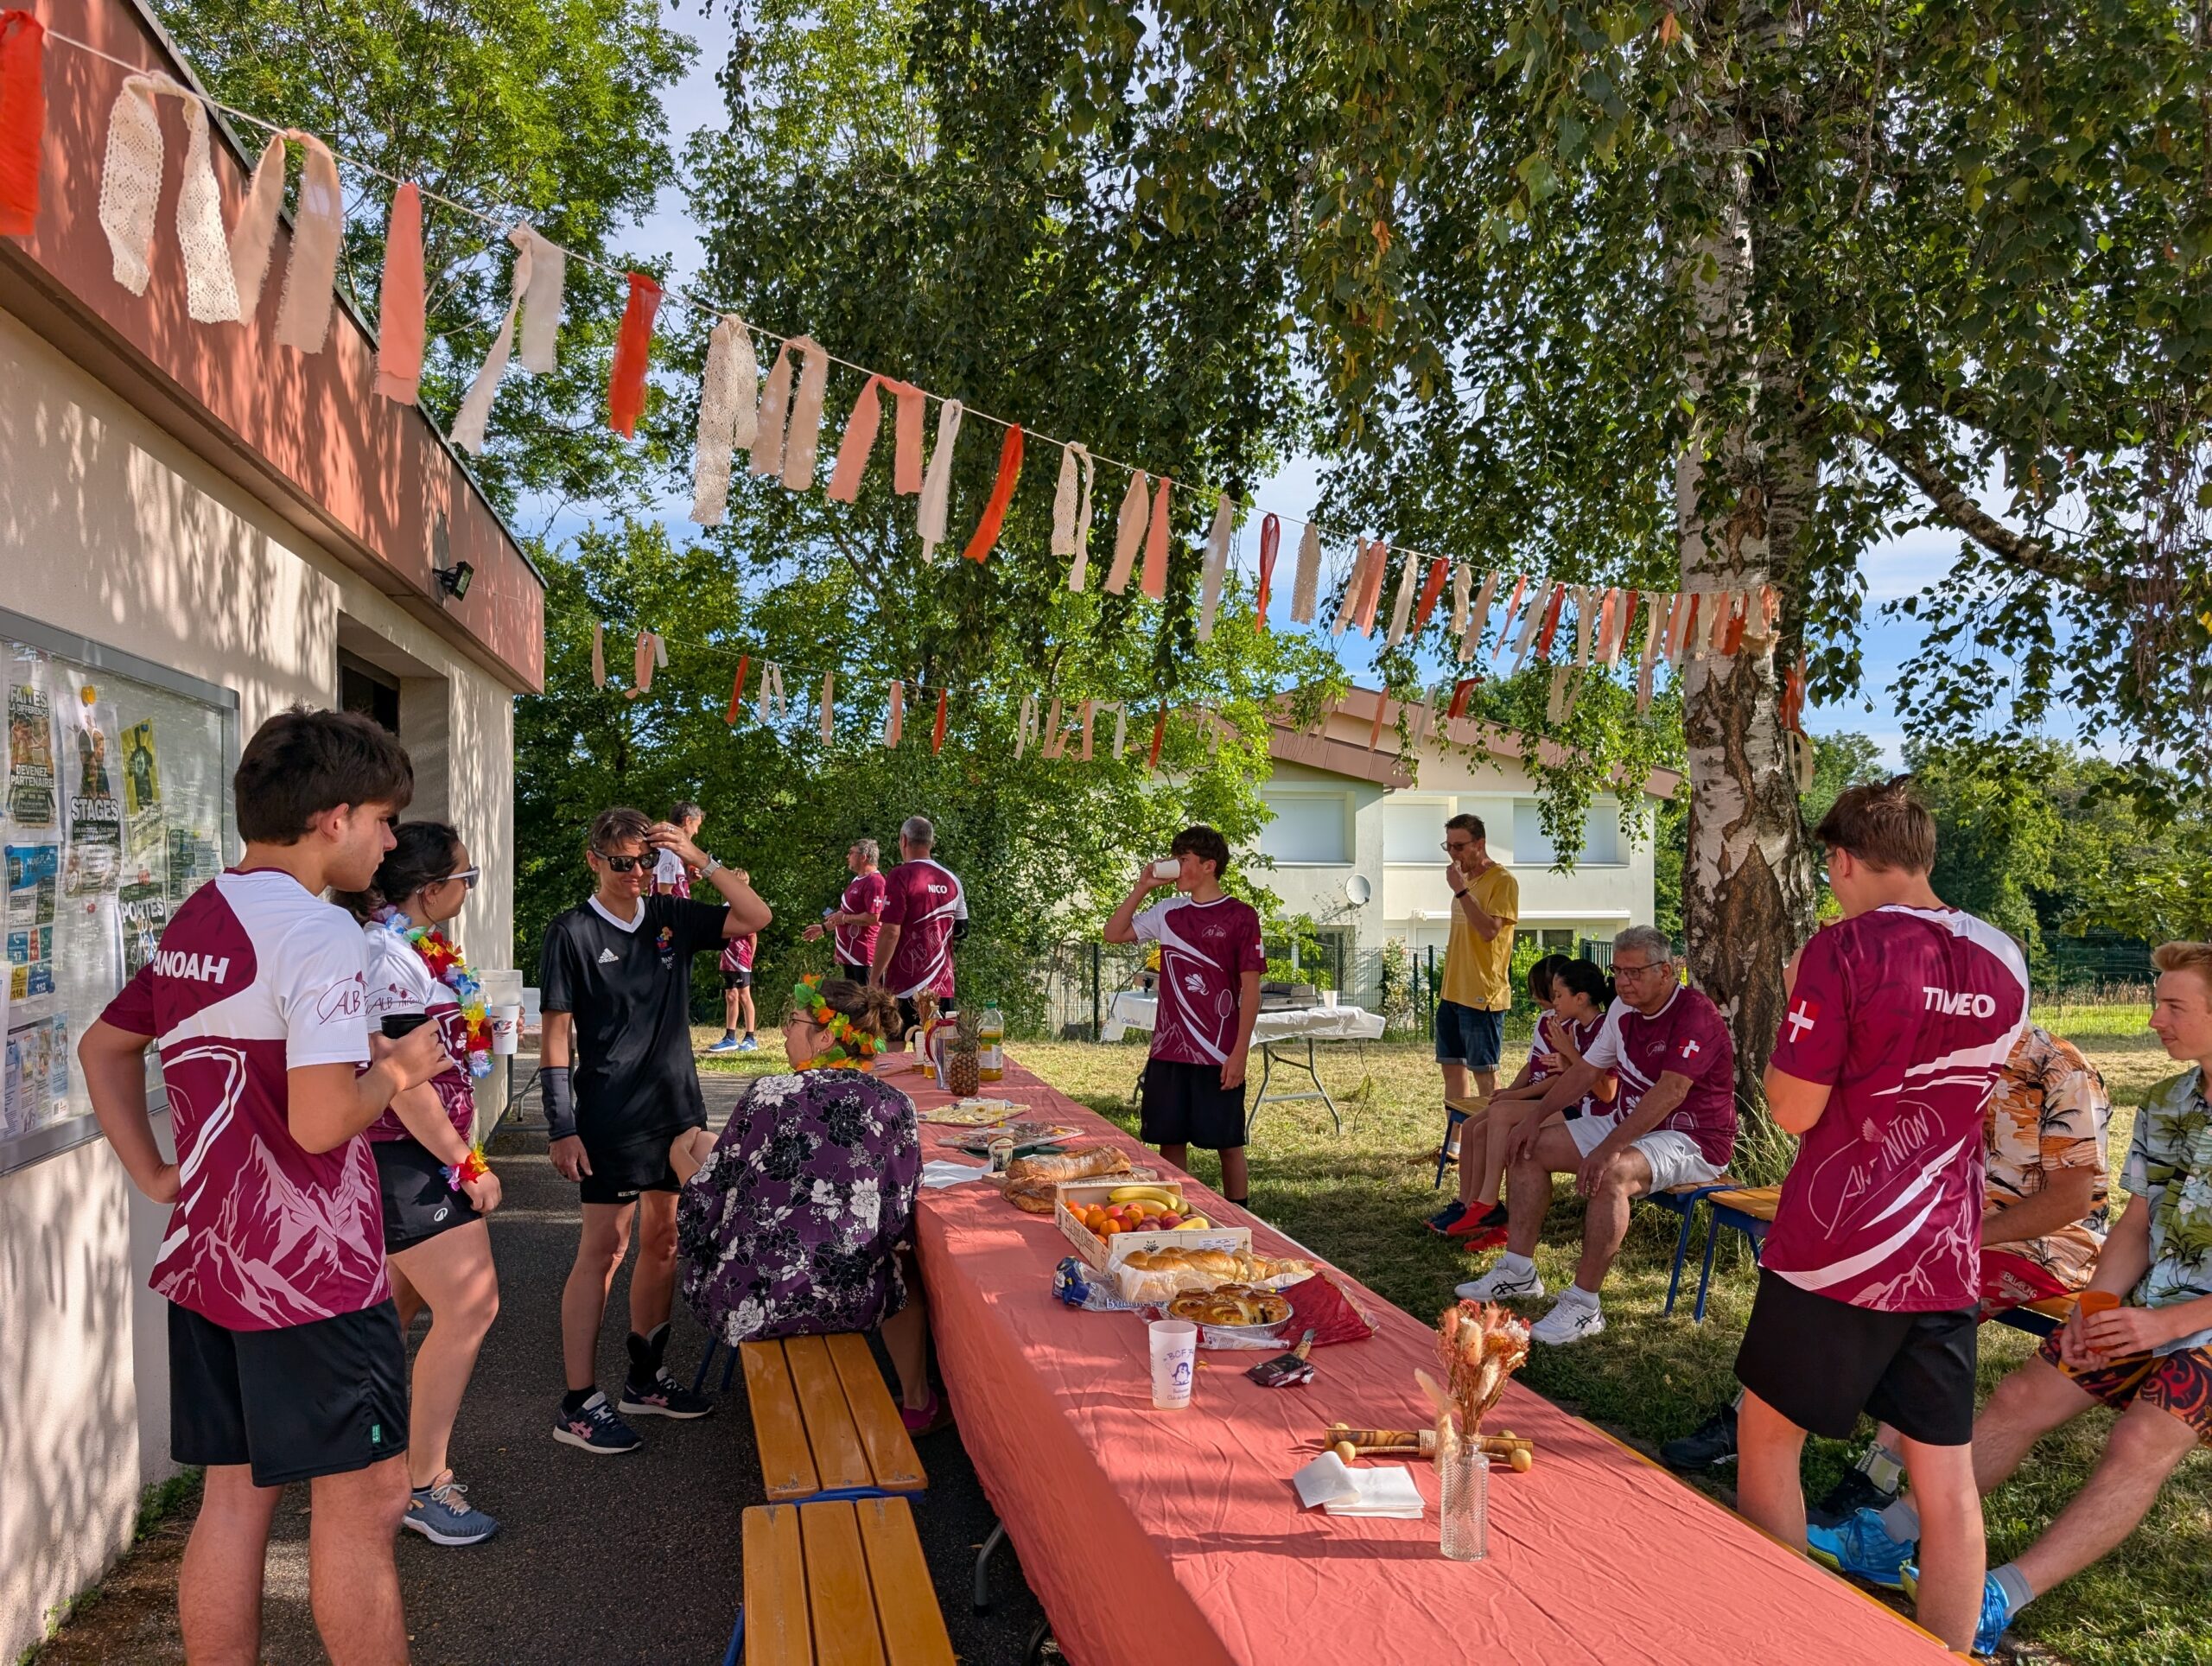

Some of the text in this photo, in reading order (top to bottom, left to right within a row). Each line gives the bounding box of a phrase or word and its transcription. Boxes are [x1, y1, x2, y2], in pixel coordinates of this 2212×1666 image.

[16, 764, 48, 778] DEVENEZ
[10, 775, 54, 788] PARTENAIRE
[71, 797, 119, 822] STAGES
[927, 883, 948, 894] NICO
[121, 897, 164, 924] PORTES
[598, 955, 620, 963] adidas
[1923, 986, 1996, 1018] TIMEO
